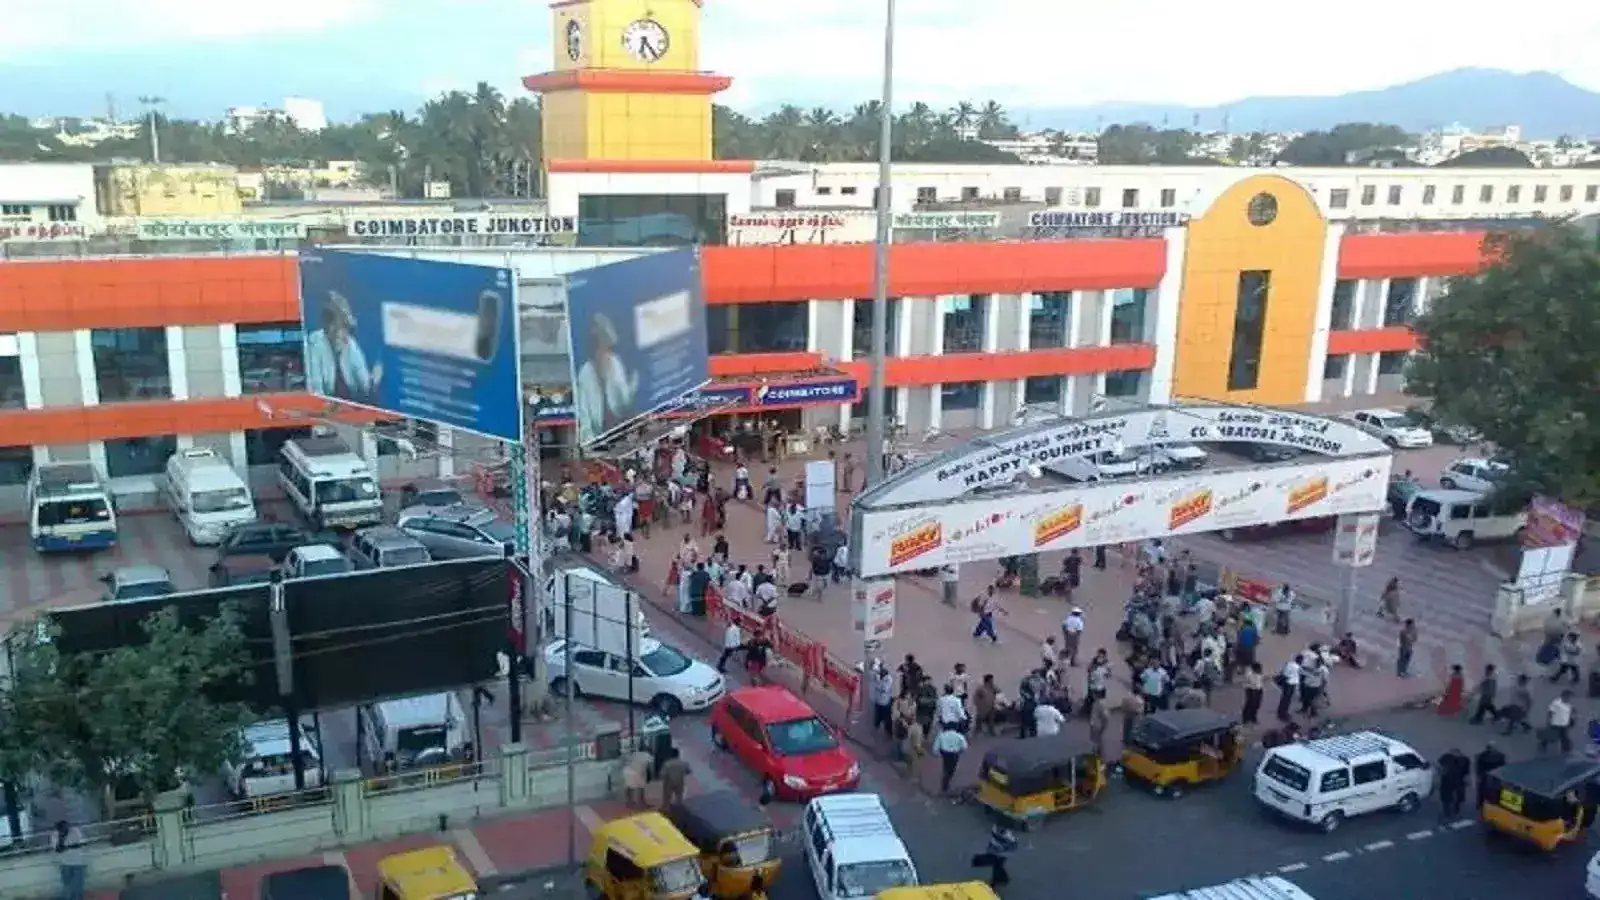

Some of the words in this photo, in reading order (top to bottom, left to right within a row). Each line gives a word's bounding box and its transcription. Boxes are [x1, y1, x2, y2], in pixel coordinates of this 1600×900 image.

[353, 217, 478, 235] COIMBATORE
[486, 216, 574, 233] JUNCTION
[1190, 426, 1276, 440] COMBATORE
[963, 458, 1022, 486] HAPPY
